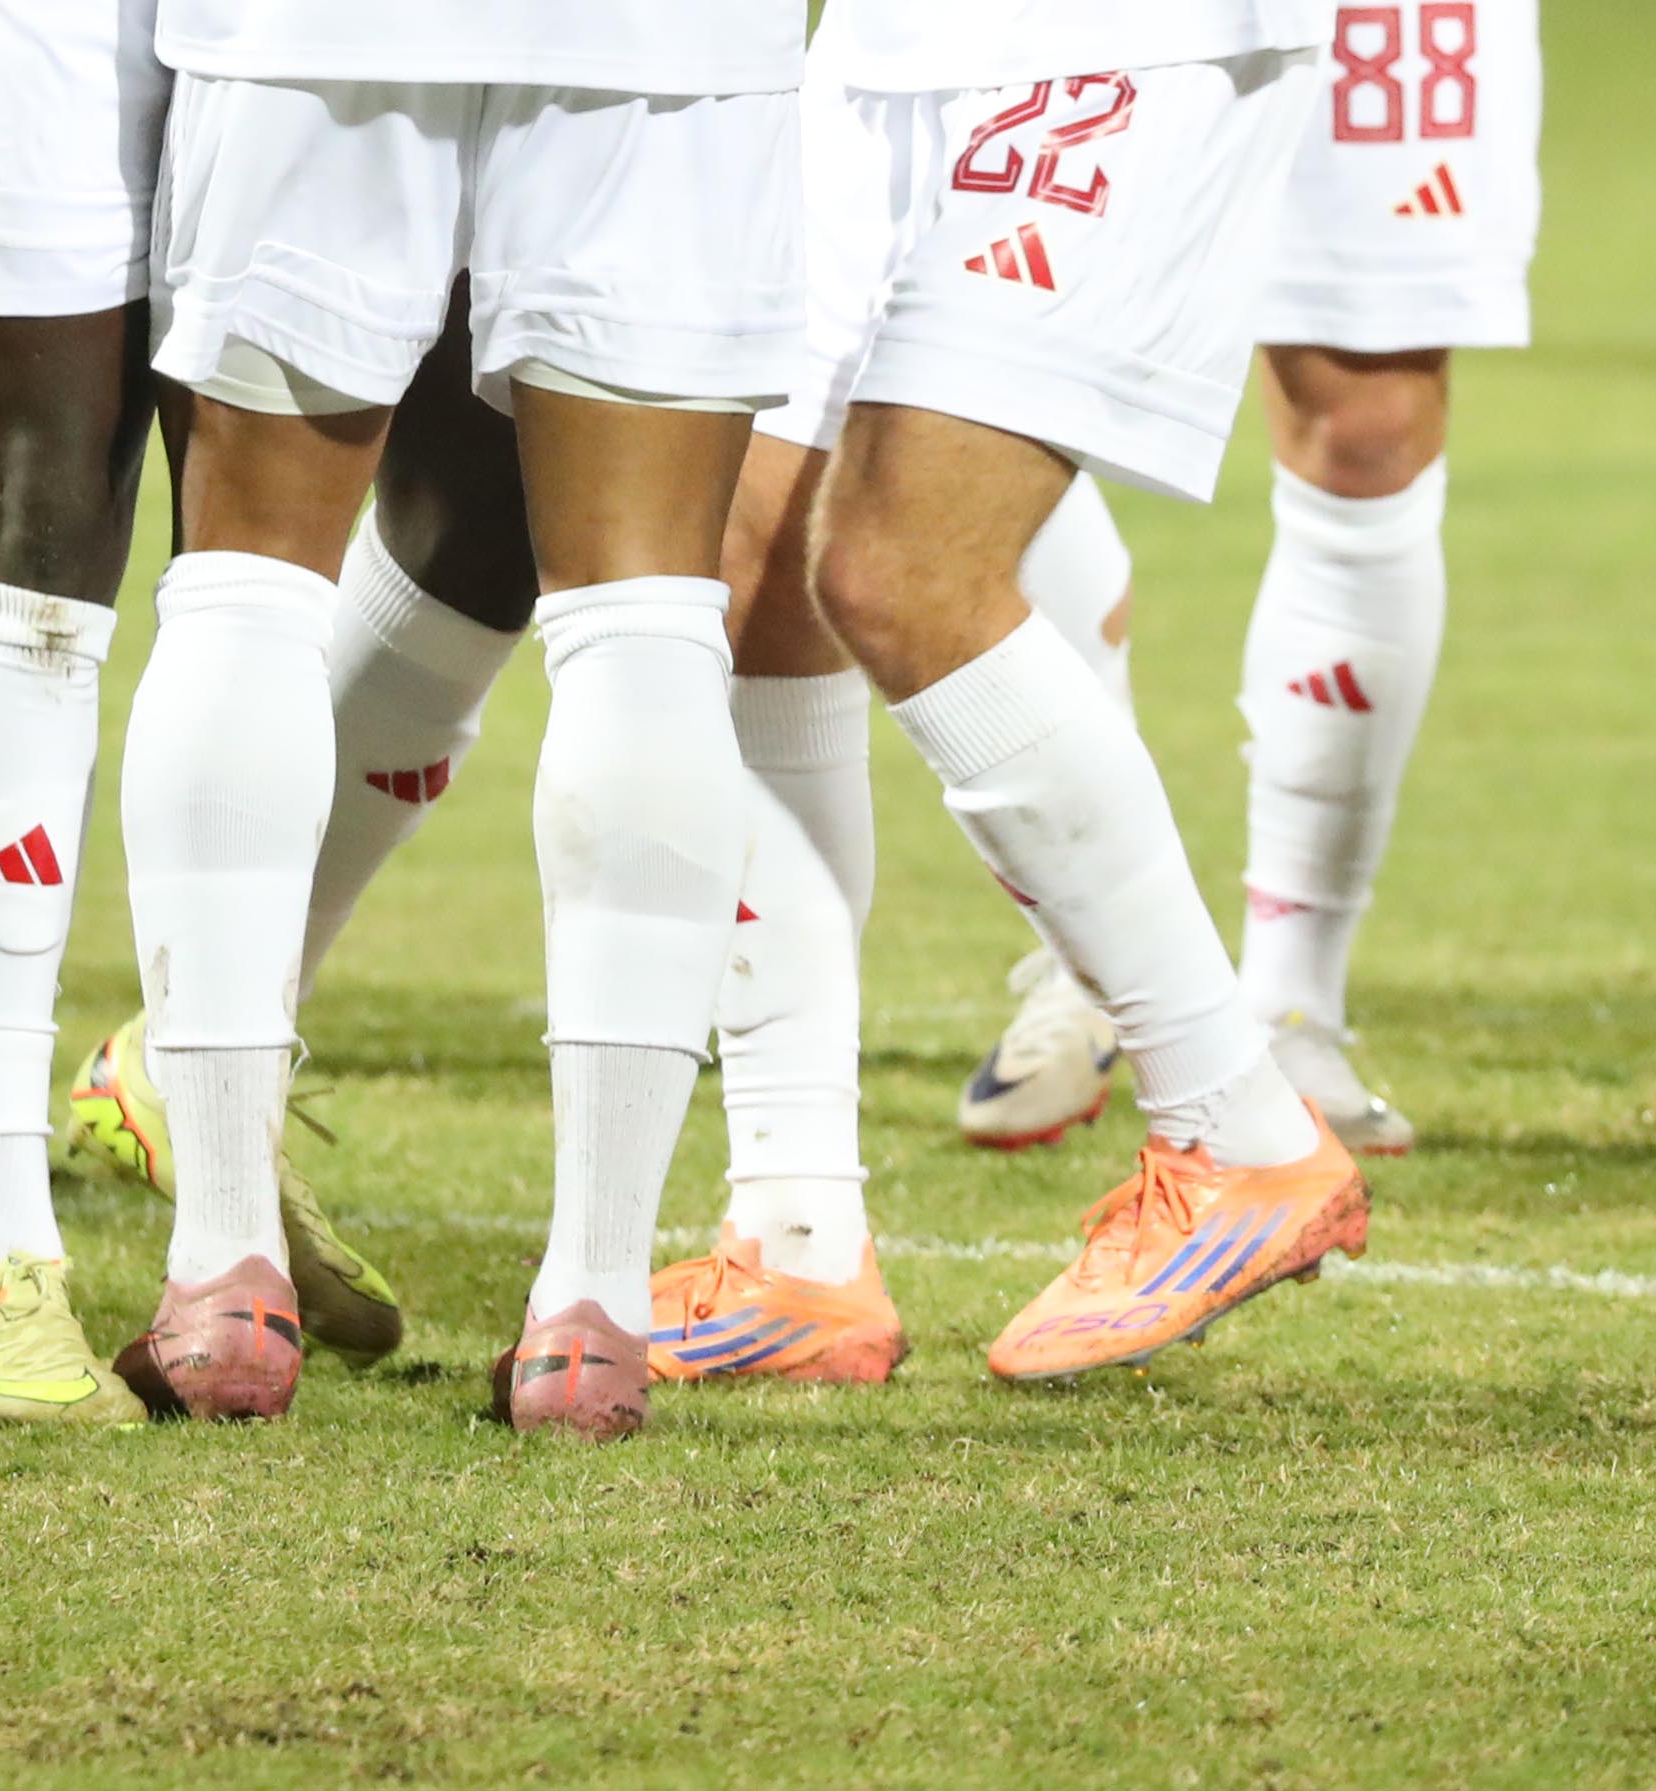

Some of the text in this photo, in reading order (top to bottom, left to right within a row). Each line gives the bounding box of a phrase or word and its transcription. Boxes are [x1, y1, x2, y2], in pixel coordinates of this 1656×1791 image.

[1332, 1, 1476, 143] 88
[951, 69, 1138, 219] 22
[1016, 1303, 1169, 1350] F50
